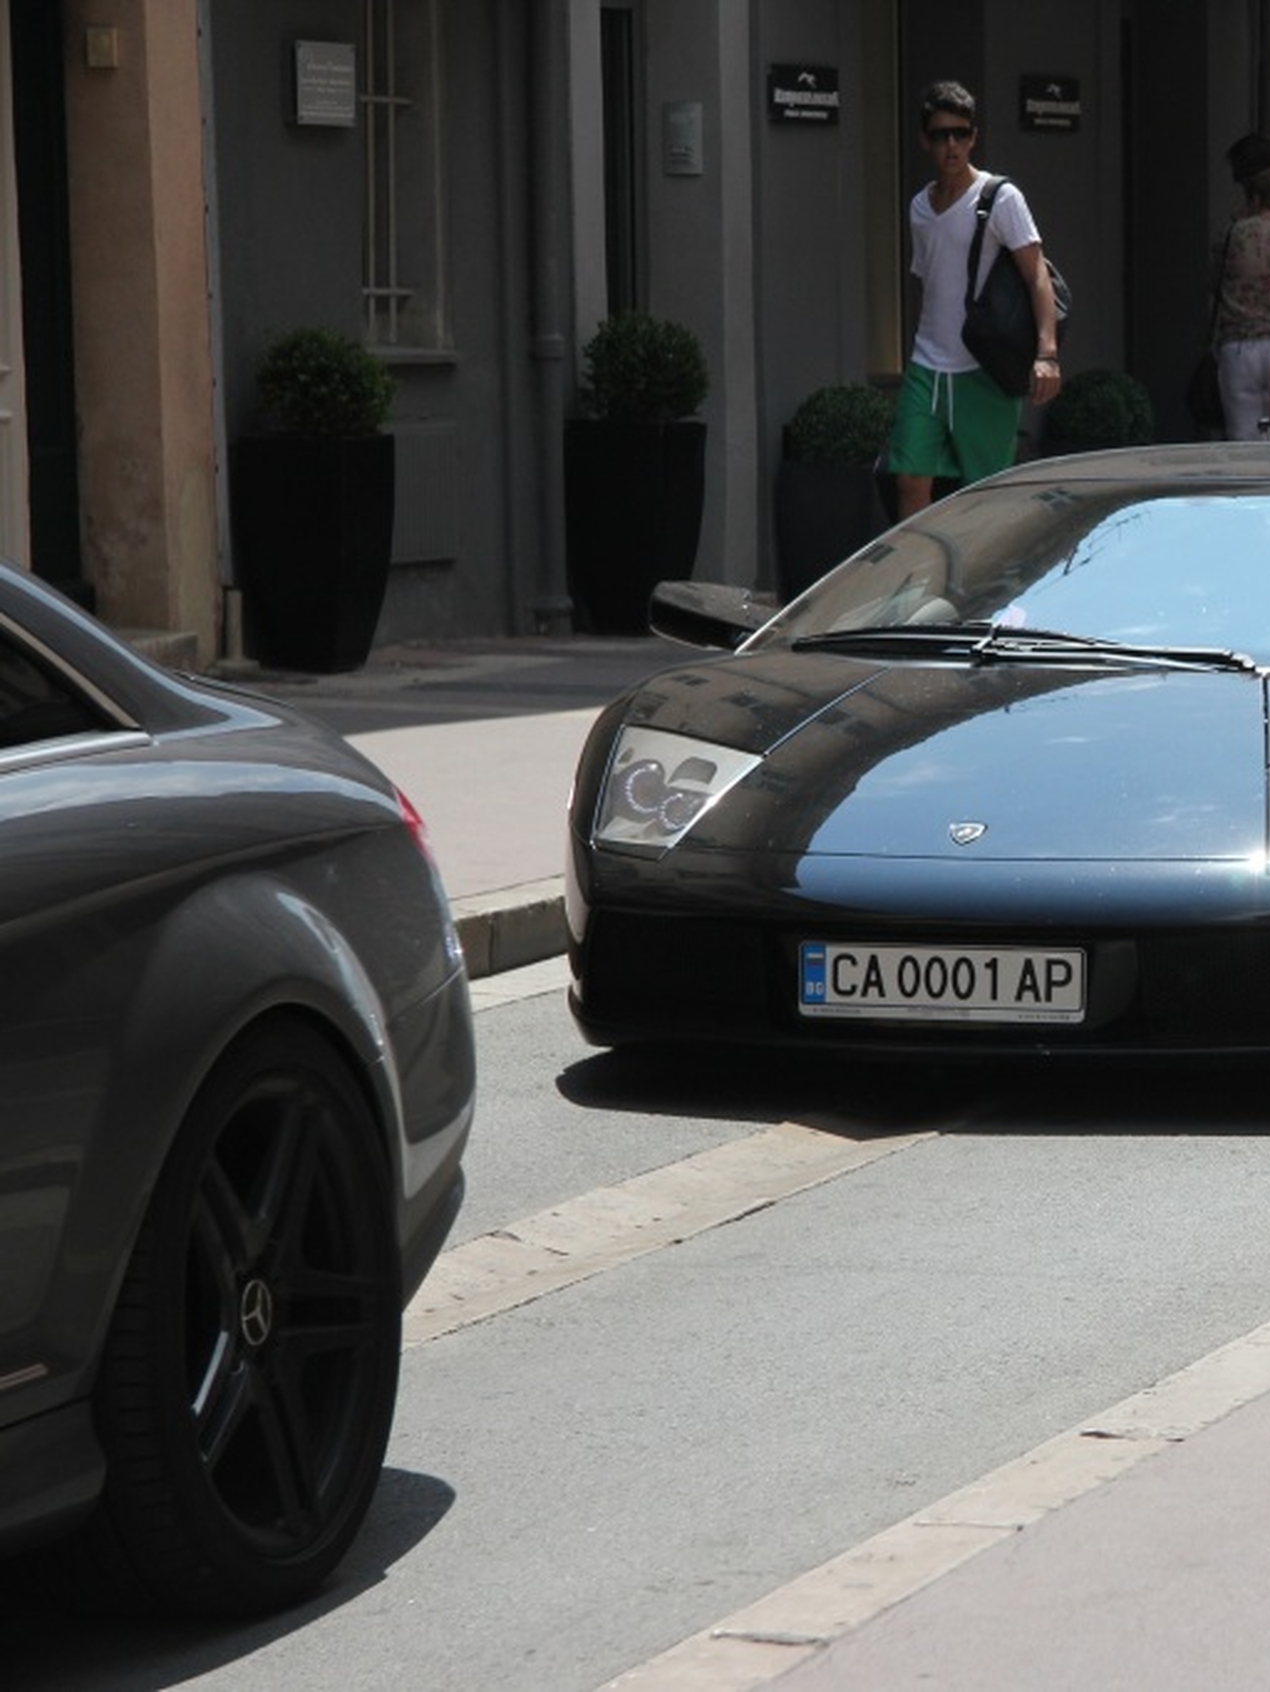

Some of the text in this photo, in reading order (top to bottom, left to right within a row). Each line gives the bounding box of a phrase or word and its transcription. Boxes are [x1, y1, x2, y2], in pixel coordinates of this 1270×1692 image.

[831, 953, 1073, 1003] CA 0001 AP
